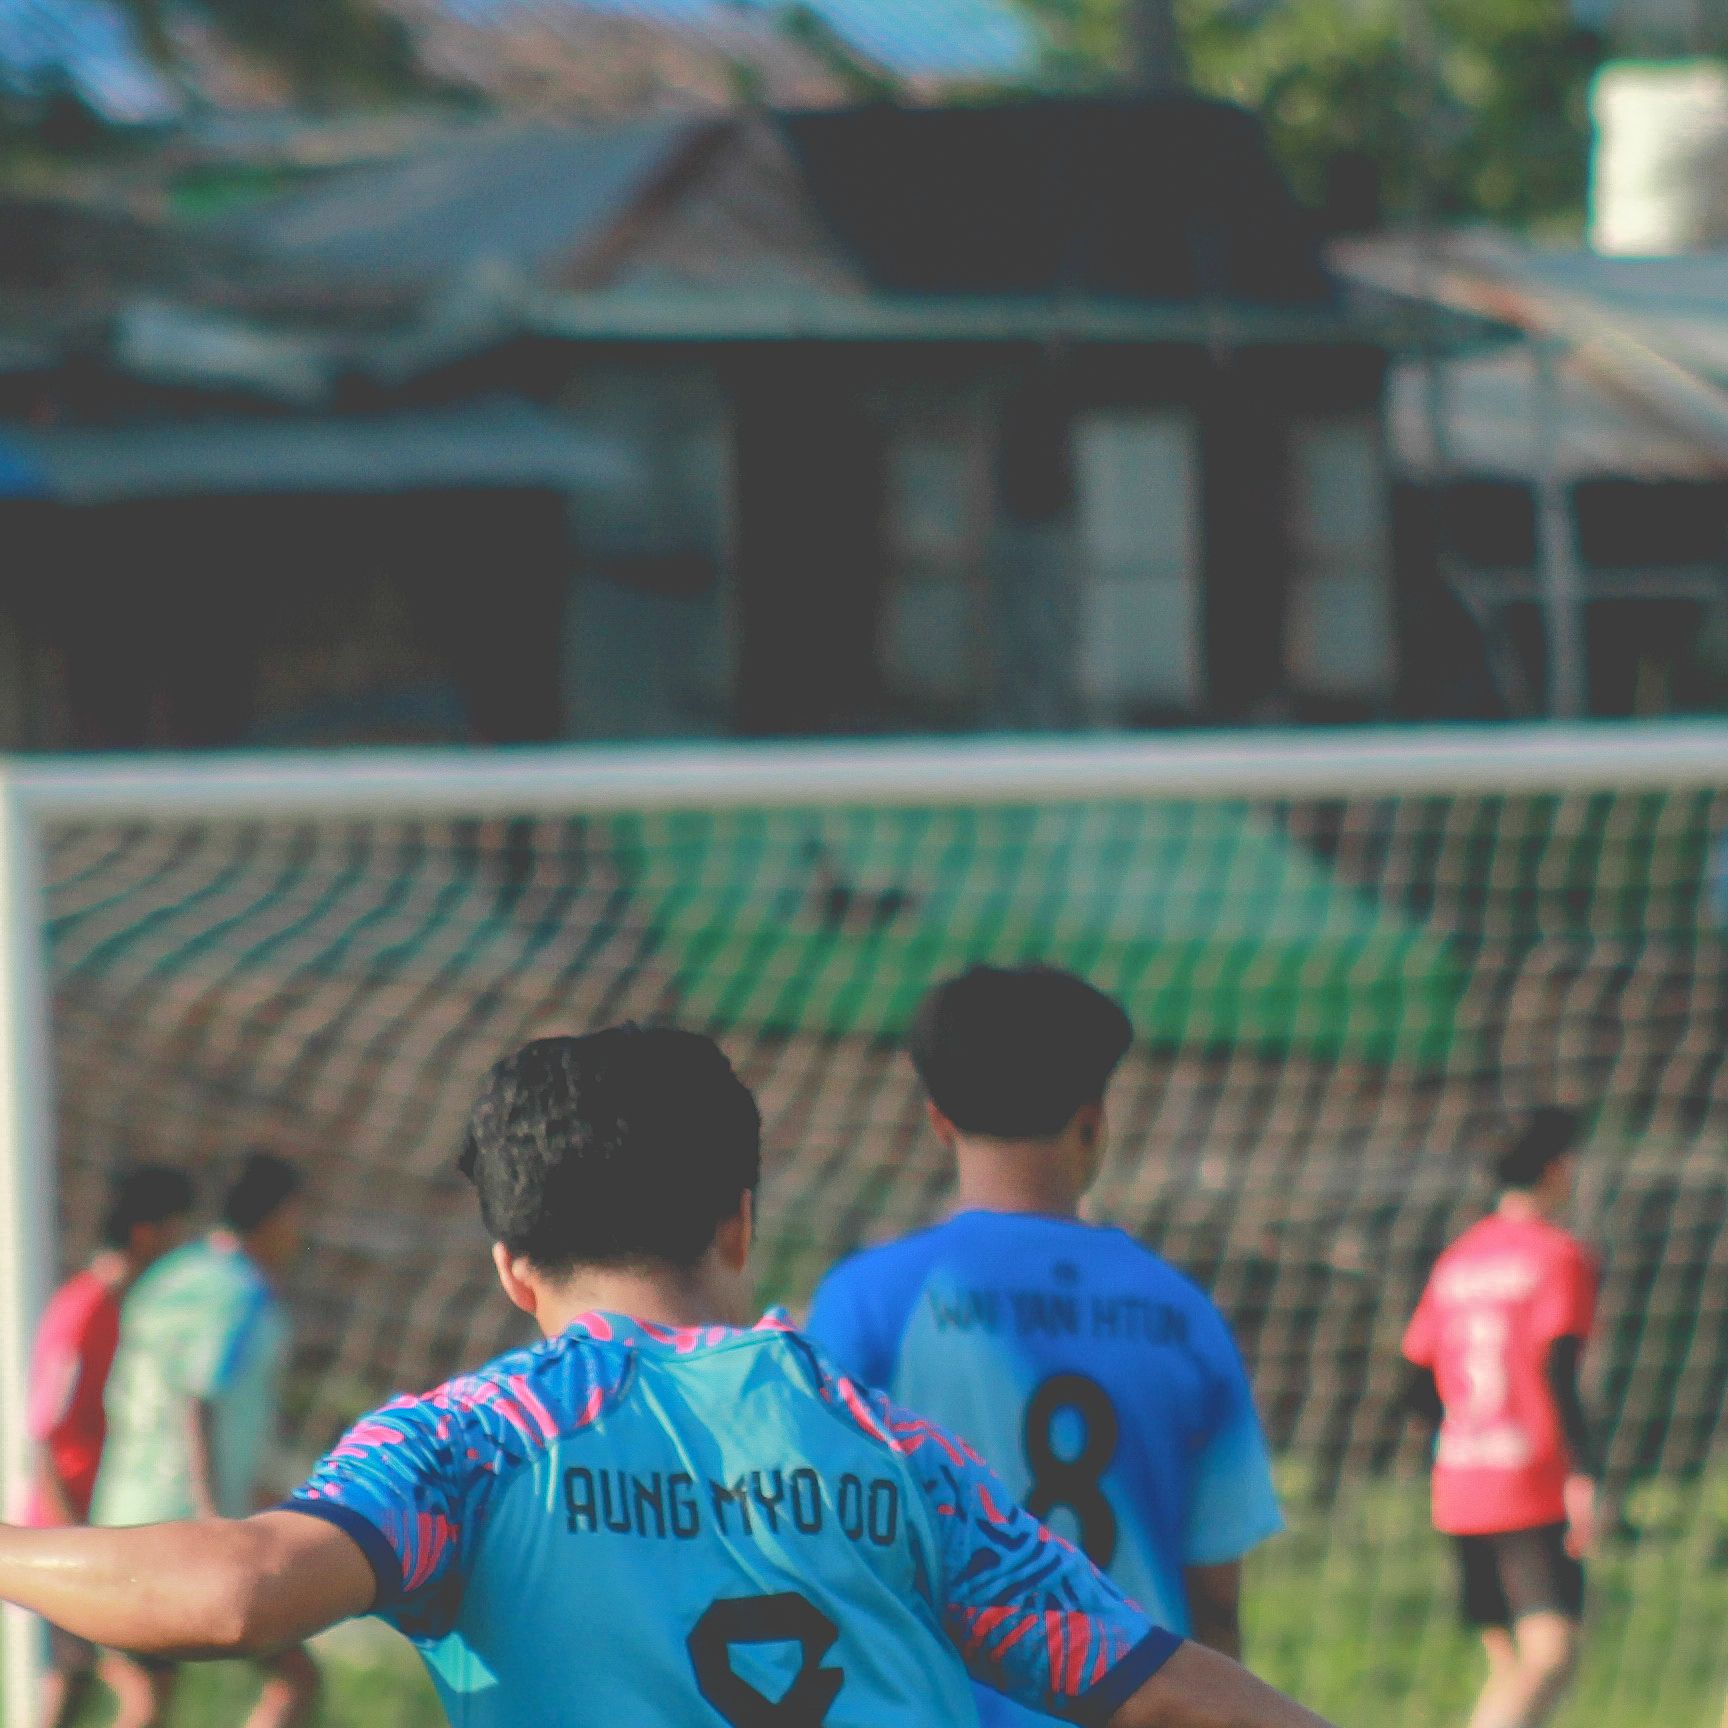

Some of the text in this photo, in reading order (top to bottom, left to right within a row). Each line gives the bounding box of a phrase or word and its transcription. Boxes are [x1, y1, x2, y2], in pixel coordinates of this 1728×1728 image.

[565, 1467, 701, 1540] AUNG
[709, 1467, 823, 1536] MYO
[1026, 1372, 1119, 1570] 8
